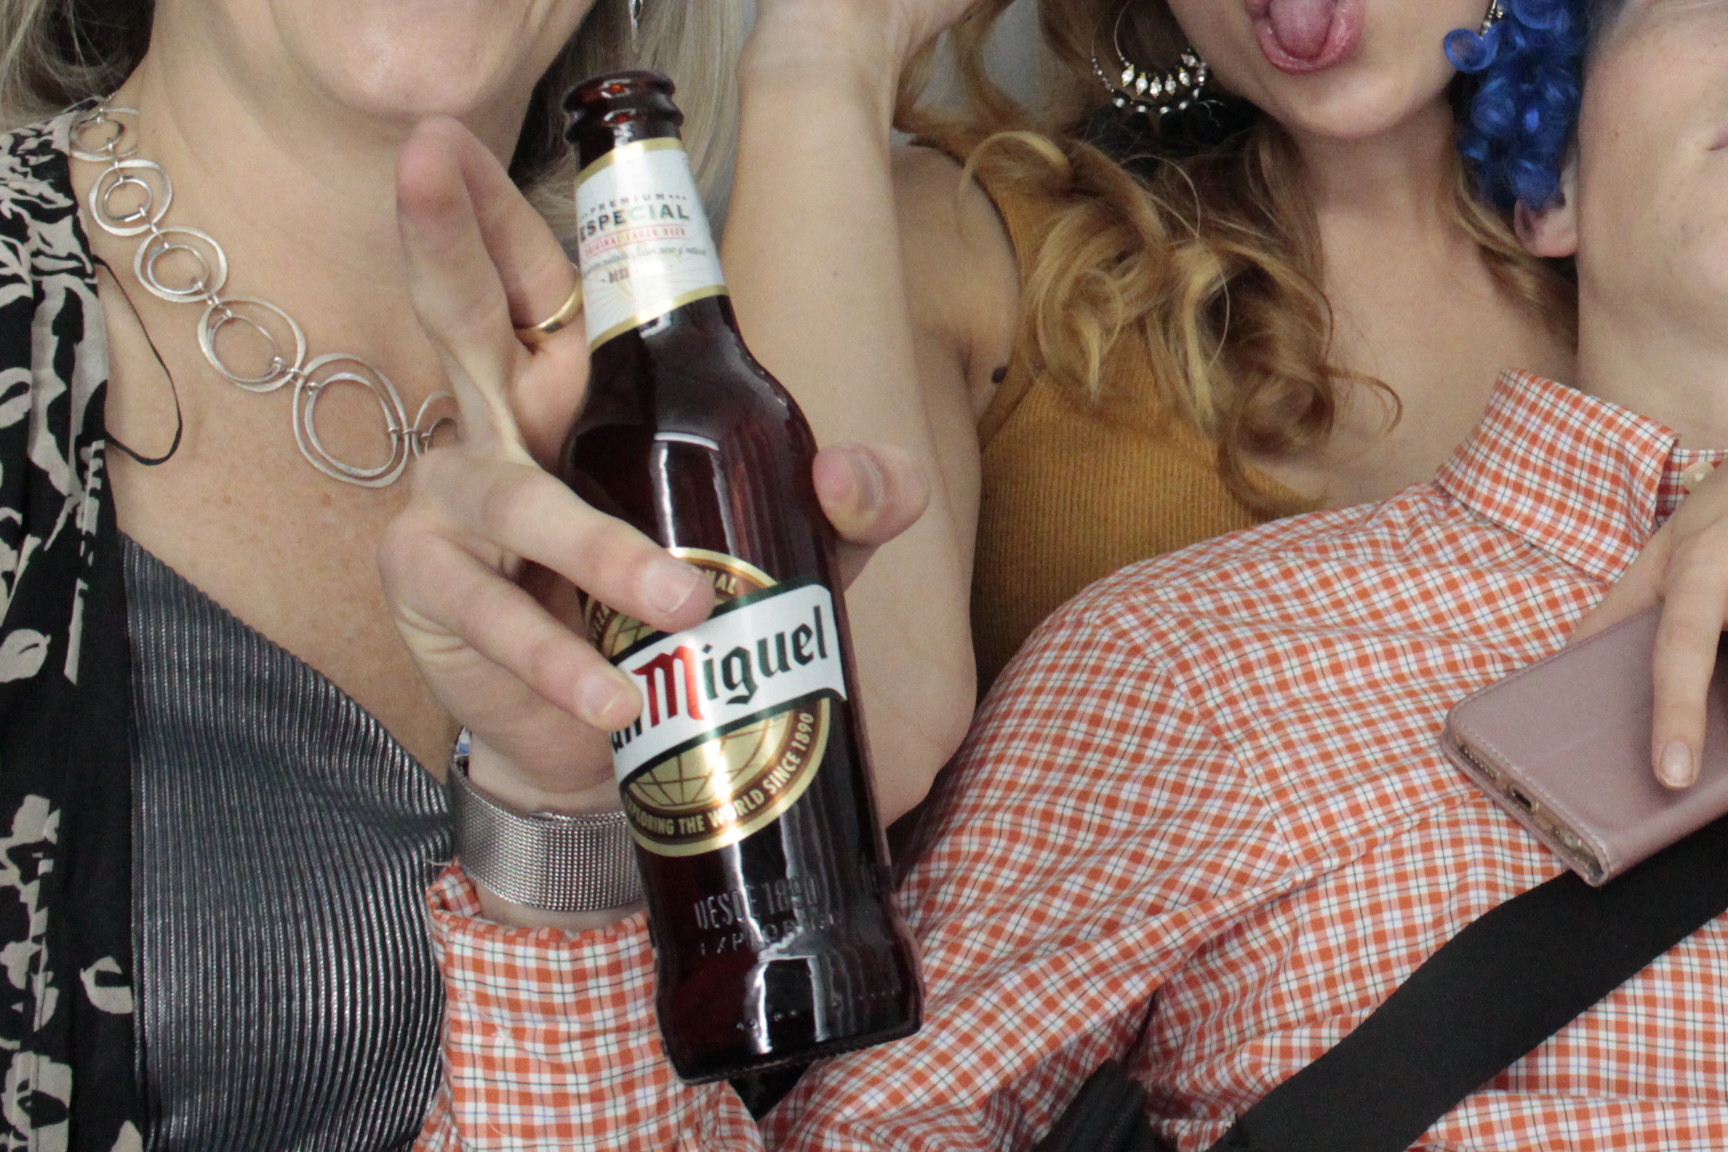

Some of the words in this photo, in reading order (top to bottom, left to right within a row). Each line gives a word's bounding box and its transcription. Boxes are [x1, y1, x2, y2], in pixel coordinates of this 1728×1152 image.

[580, 203, 690, 242] ESPECIAL
[590, 193, 665, 215] PREMIUM
[631, 605, 829, 728] Miguel
[678, 814, 705, 836] THE
[708, 790, 765, 828] WORLD
[763, 752, 801, 795] SINCE
[792, 712, 814, 751] 1890
